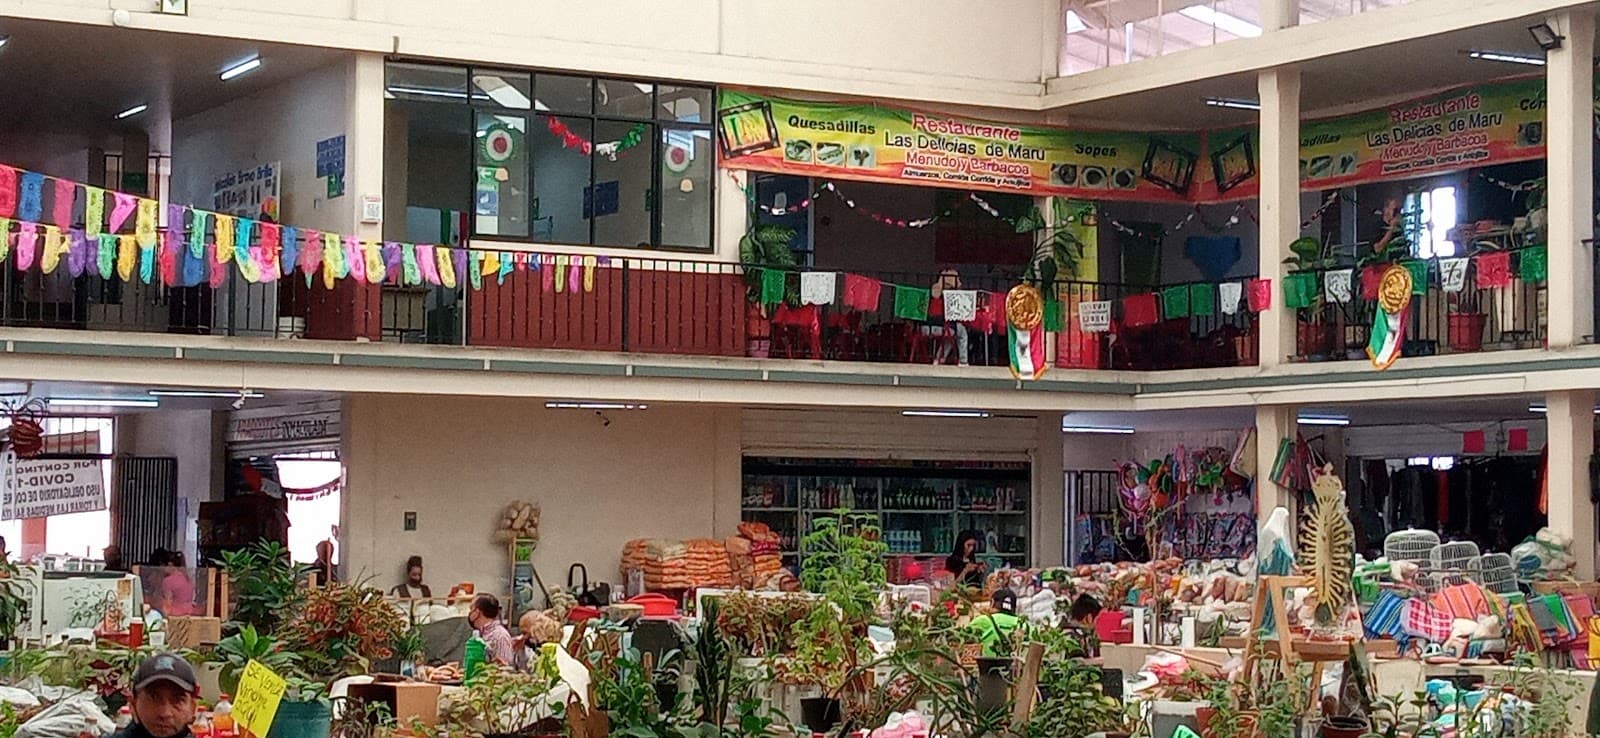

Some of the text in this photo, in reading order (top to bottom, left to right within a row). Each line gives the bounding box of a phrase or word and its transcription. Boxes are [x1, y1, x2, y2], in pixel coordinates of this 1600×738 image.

[788, 114, 876, 135] Quesadillas
[912, 113, 1020, 141] Restaurante
[1365, 112, 1503, 148] Las Delicias de Maru
[884, 131, 1046, 161] Las Delicias de Maru
[1436, 133, 1488, 151] Barbacoa
[906, 152, 1030, 176] Menudo y Barbacoa
